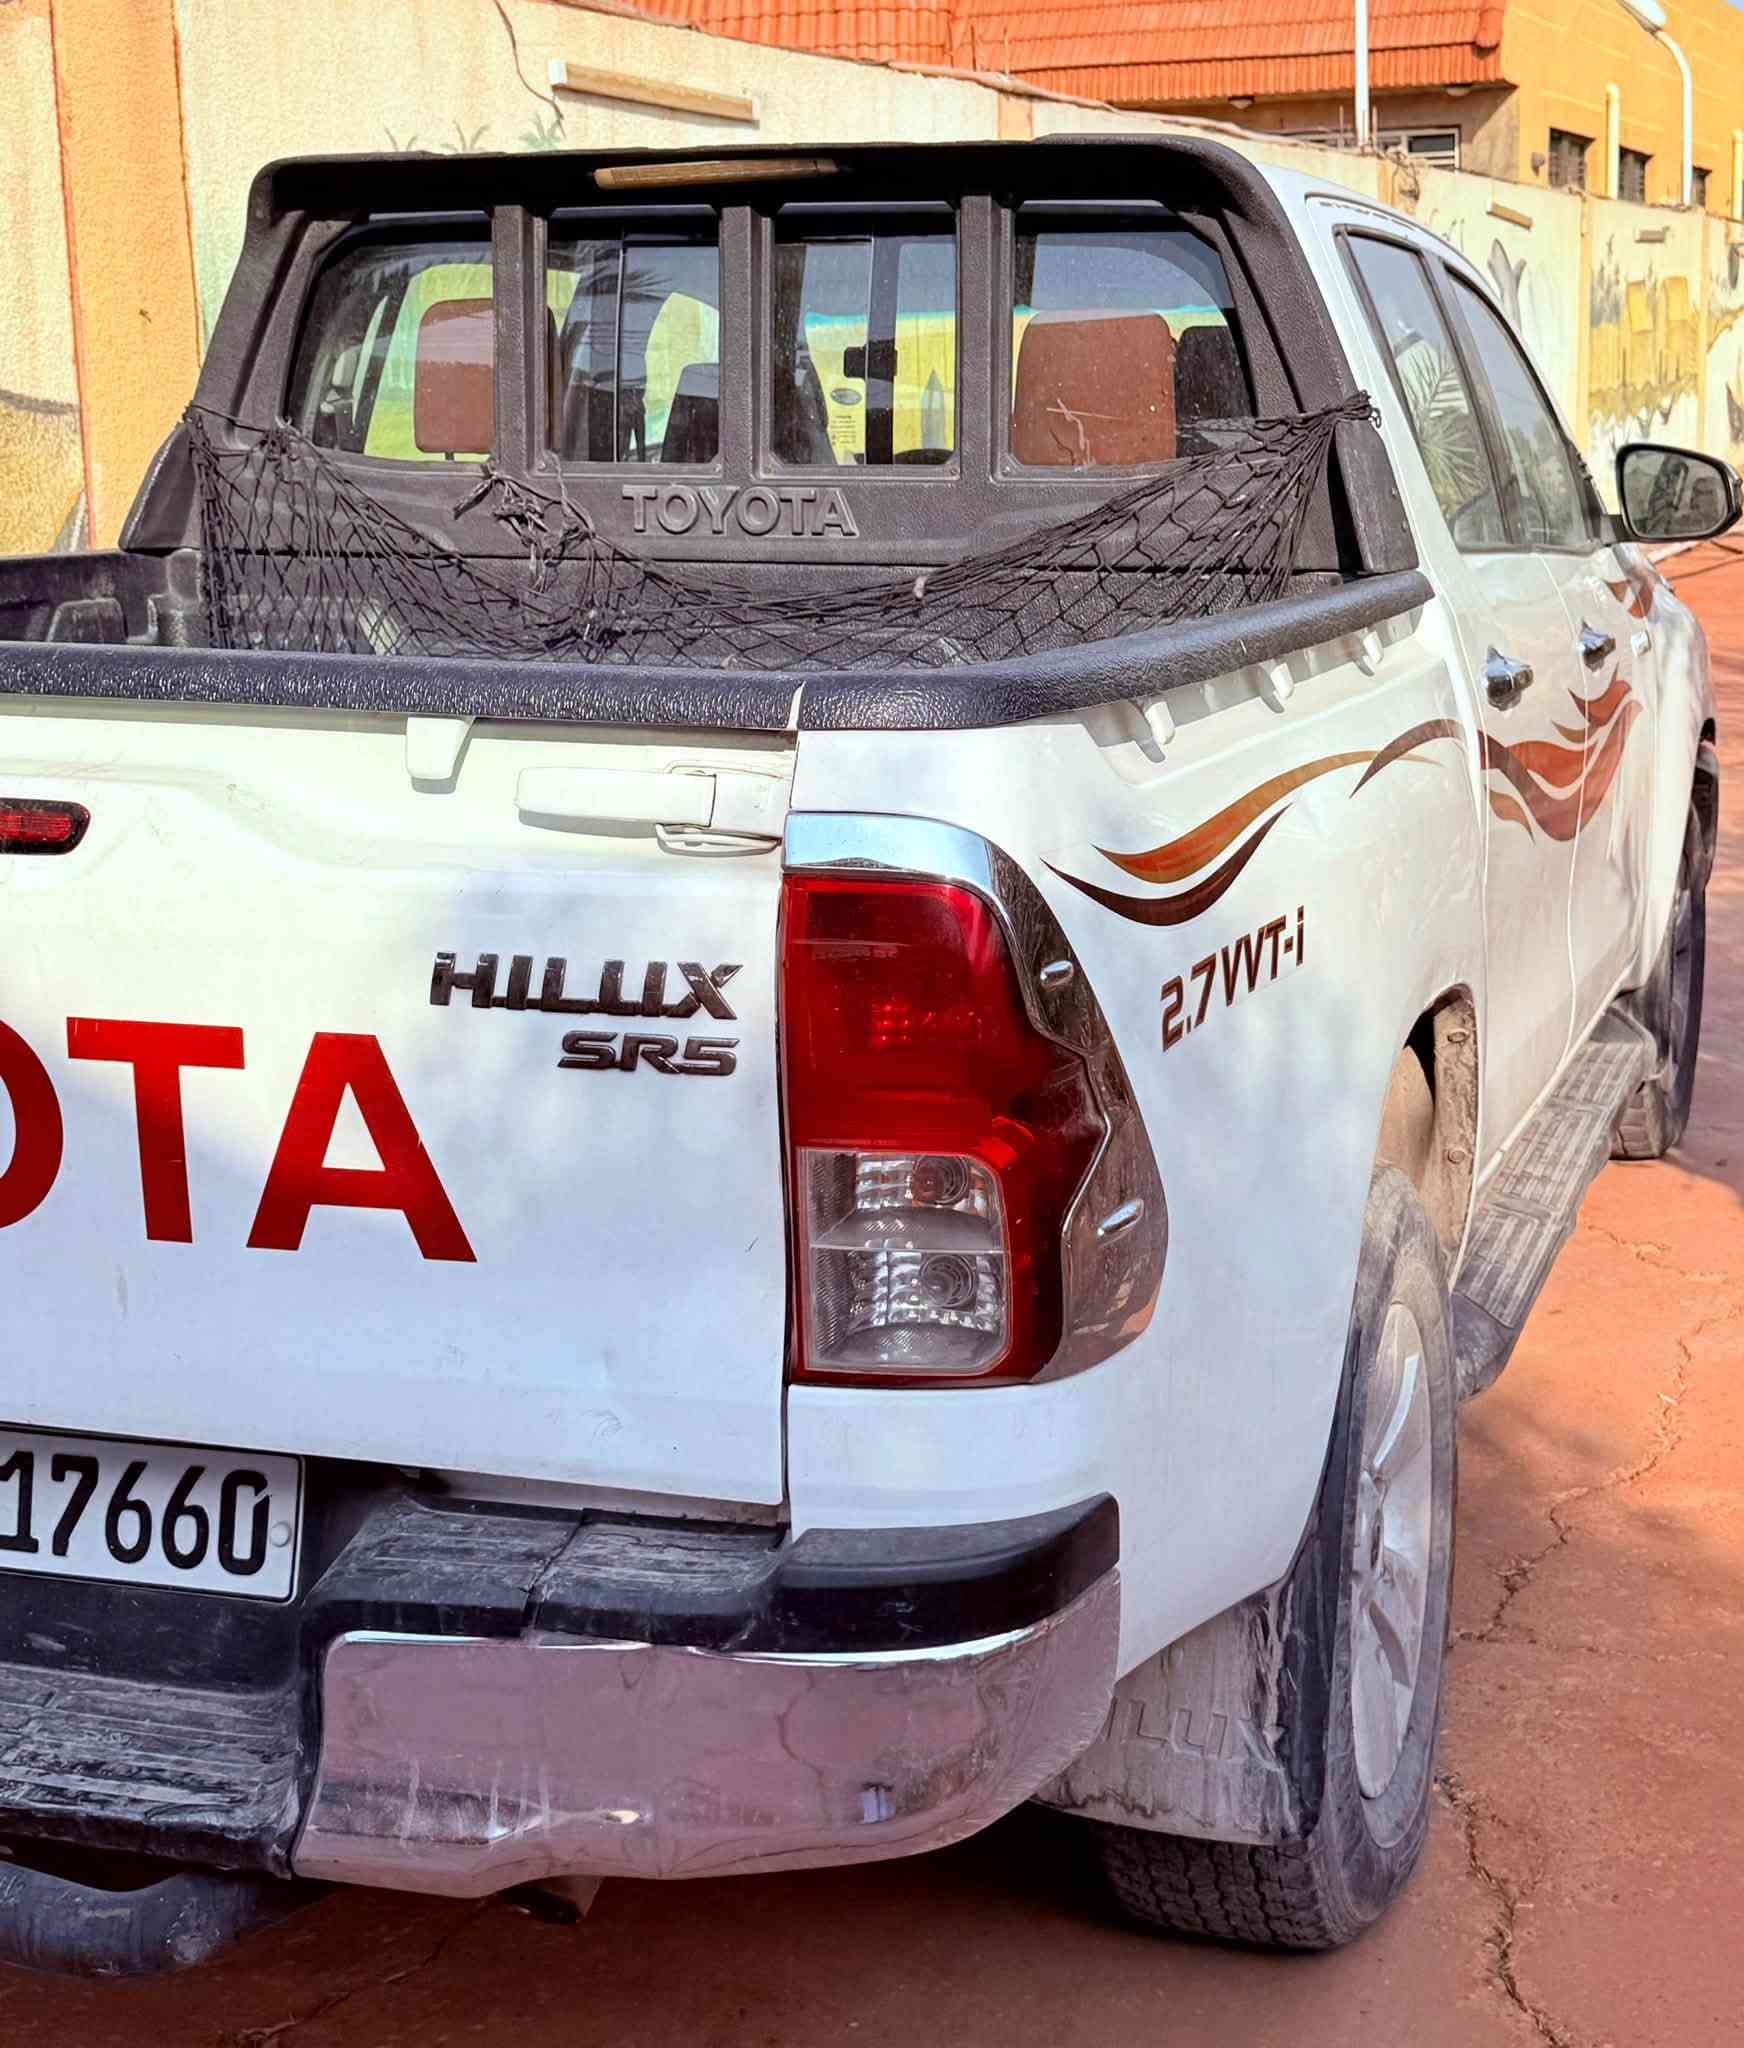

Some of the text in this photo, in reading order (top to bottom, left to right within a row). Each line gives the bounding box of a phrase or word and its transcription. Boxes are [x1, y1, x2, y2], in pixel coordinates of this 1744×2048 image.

[622, 485, 860, 537] TOYOTA
[430, 952, 744, 1020] HILUX
[557, 1030, 740, 1076] SR5
[0, 1450, 272, 1576] 17660
